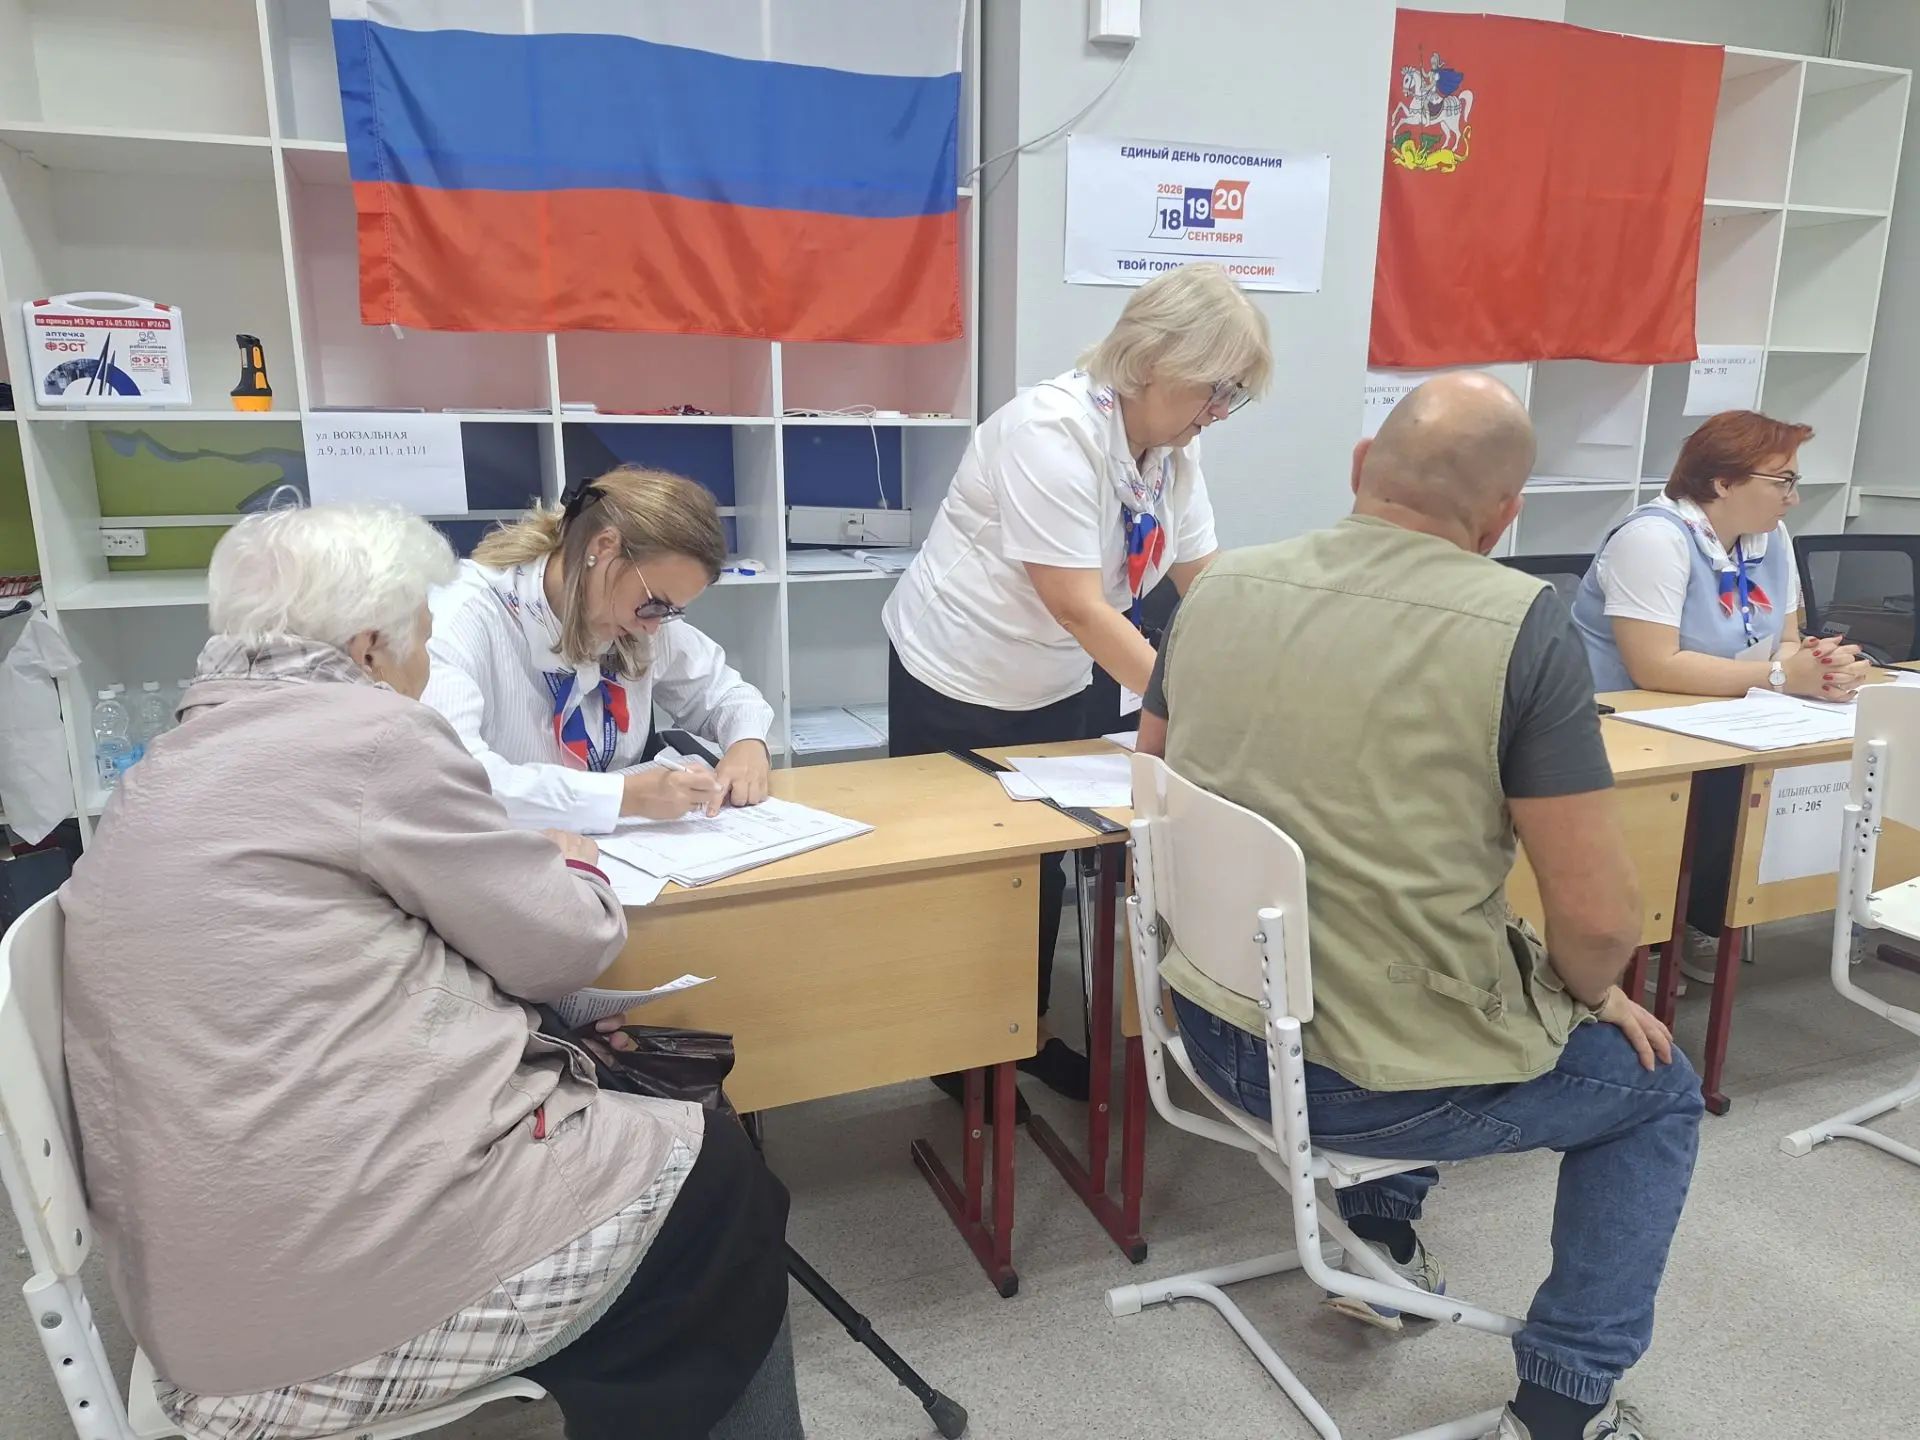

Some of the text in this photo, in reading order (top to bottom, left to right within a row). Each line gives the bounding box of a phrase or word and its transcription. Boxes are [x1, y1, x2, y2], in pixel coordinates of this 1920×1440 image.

[1120, 146, 1283, 168] ЕДИНЫЙ ДЕНЬ ГОЛОСОВАНИЯ
[1157, 183, 1183, 194] 2026
[1160, 188, 1242, 230] 18 19 20
[1187, 231, 1243, 243] СЕНТЯБРЯ
[1117, 258, 1147, 270] ТВОЙ
[1229, 264, 1275, 276] РОССИИ!
[45, 342, 86, 352] ФЭСТ
[333, 431, 408, 440] ВОКЗАЛЬНАЯ
[1778, 783, 1832, 799] ИЛЬИНСКОЕ
[1792, 803, 1796, 814] 1
[1805, 800, 1823, 812] 205
